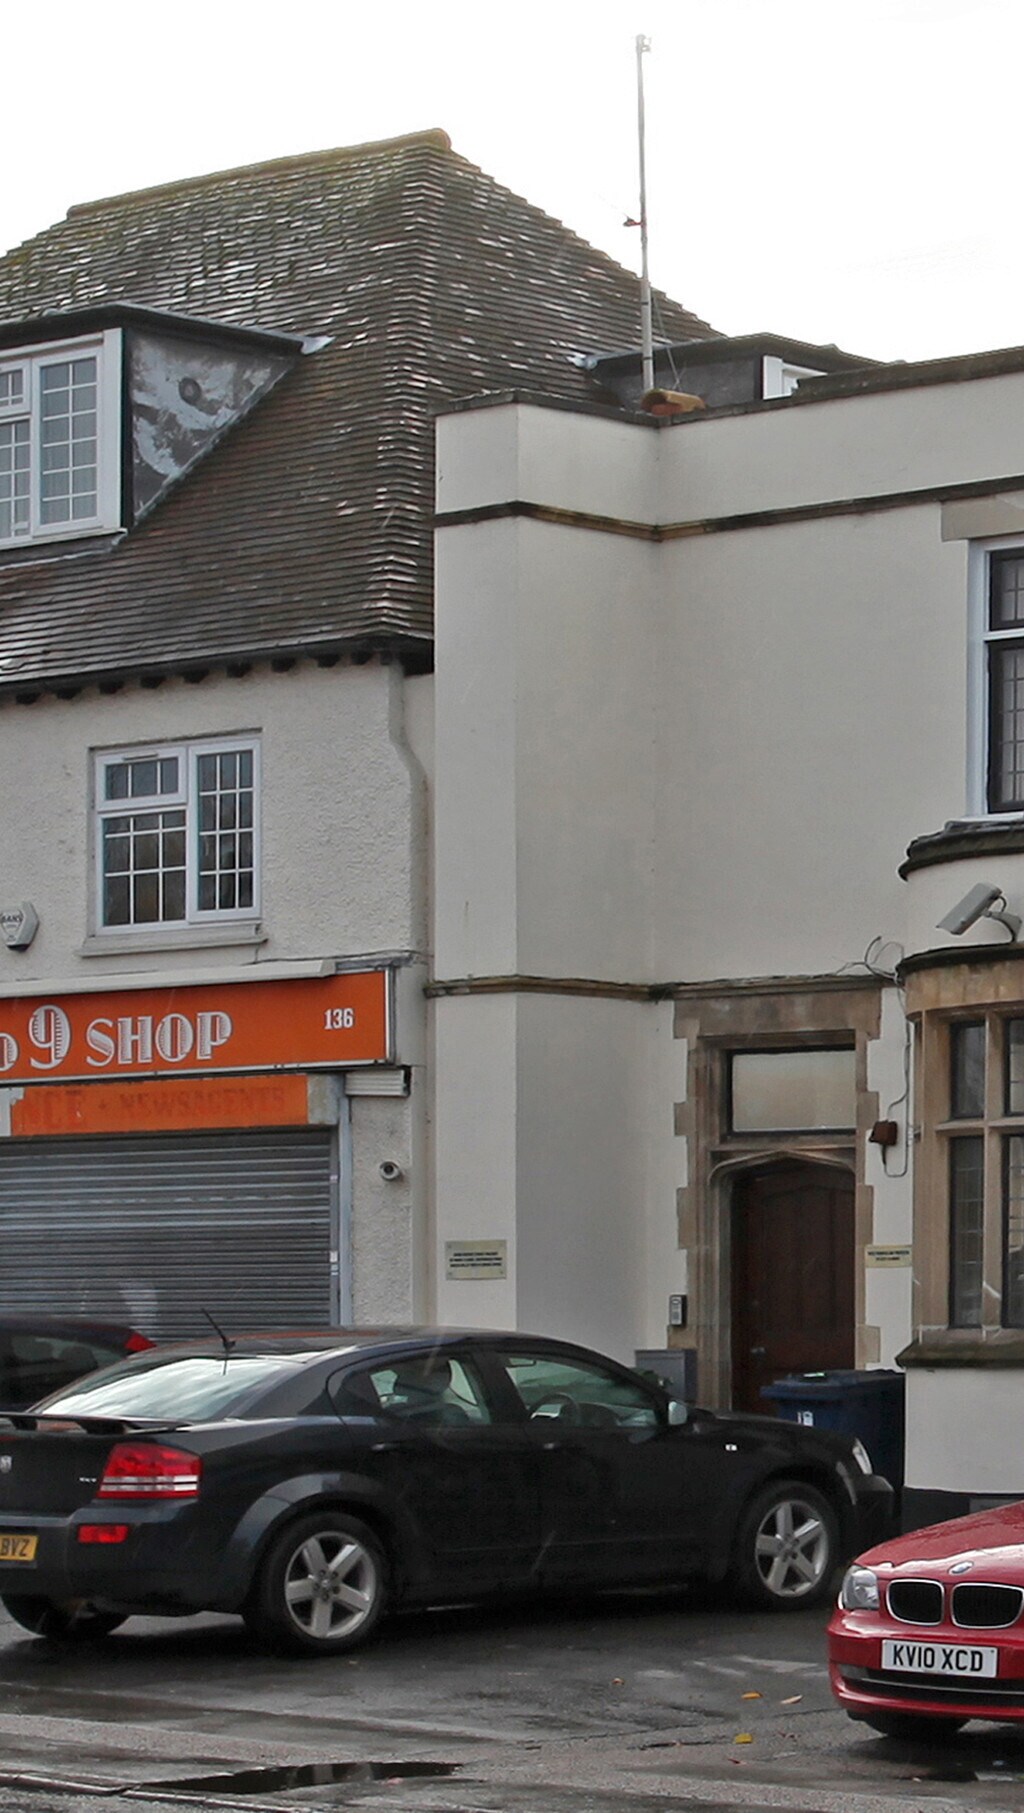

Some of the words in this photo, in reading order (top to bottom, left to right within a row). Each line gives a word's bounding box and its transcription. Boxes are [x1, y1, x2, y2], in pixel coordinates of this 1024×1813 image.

[323, 1008, 354, 1030] 136
[28, 1004, 71, 1069] 9
[86, 1010, 233, 1067] SHOP
[893, 1644, 935, 1669] KV10
[941, 1648, 983, 1672] XCD
